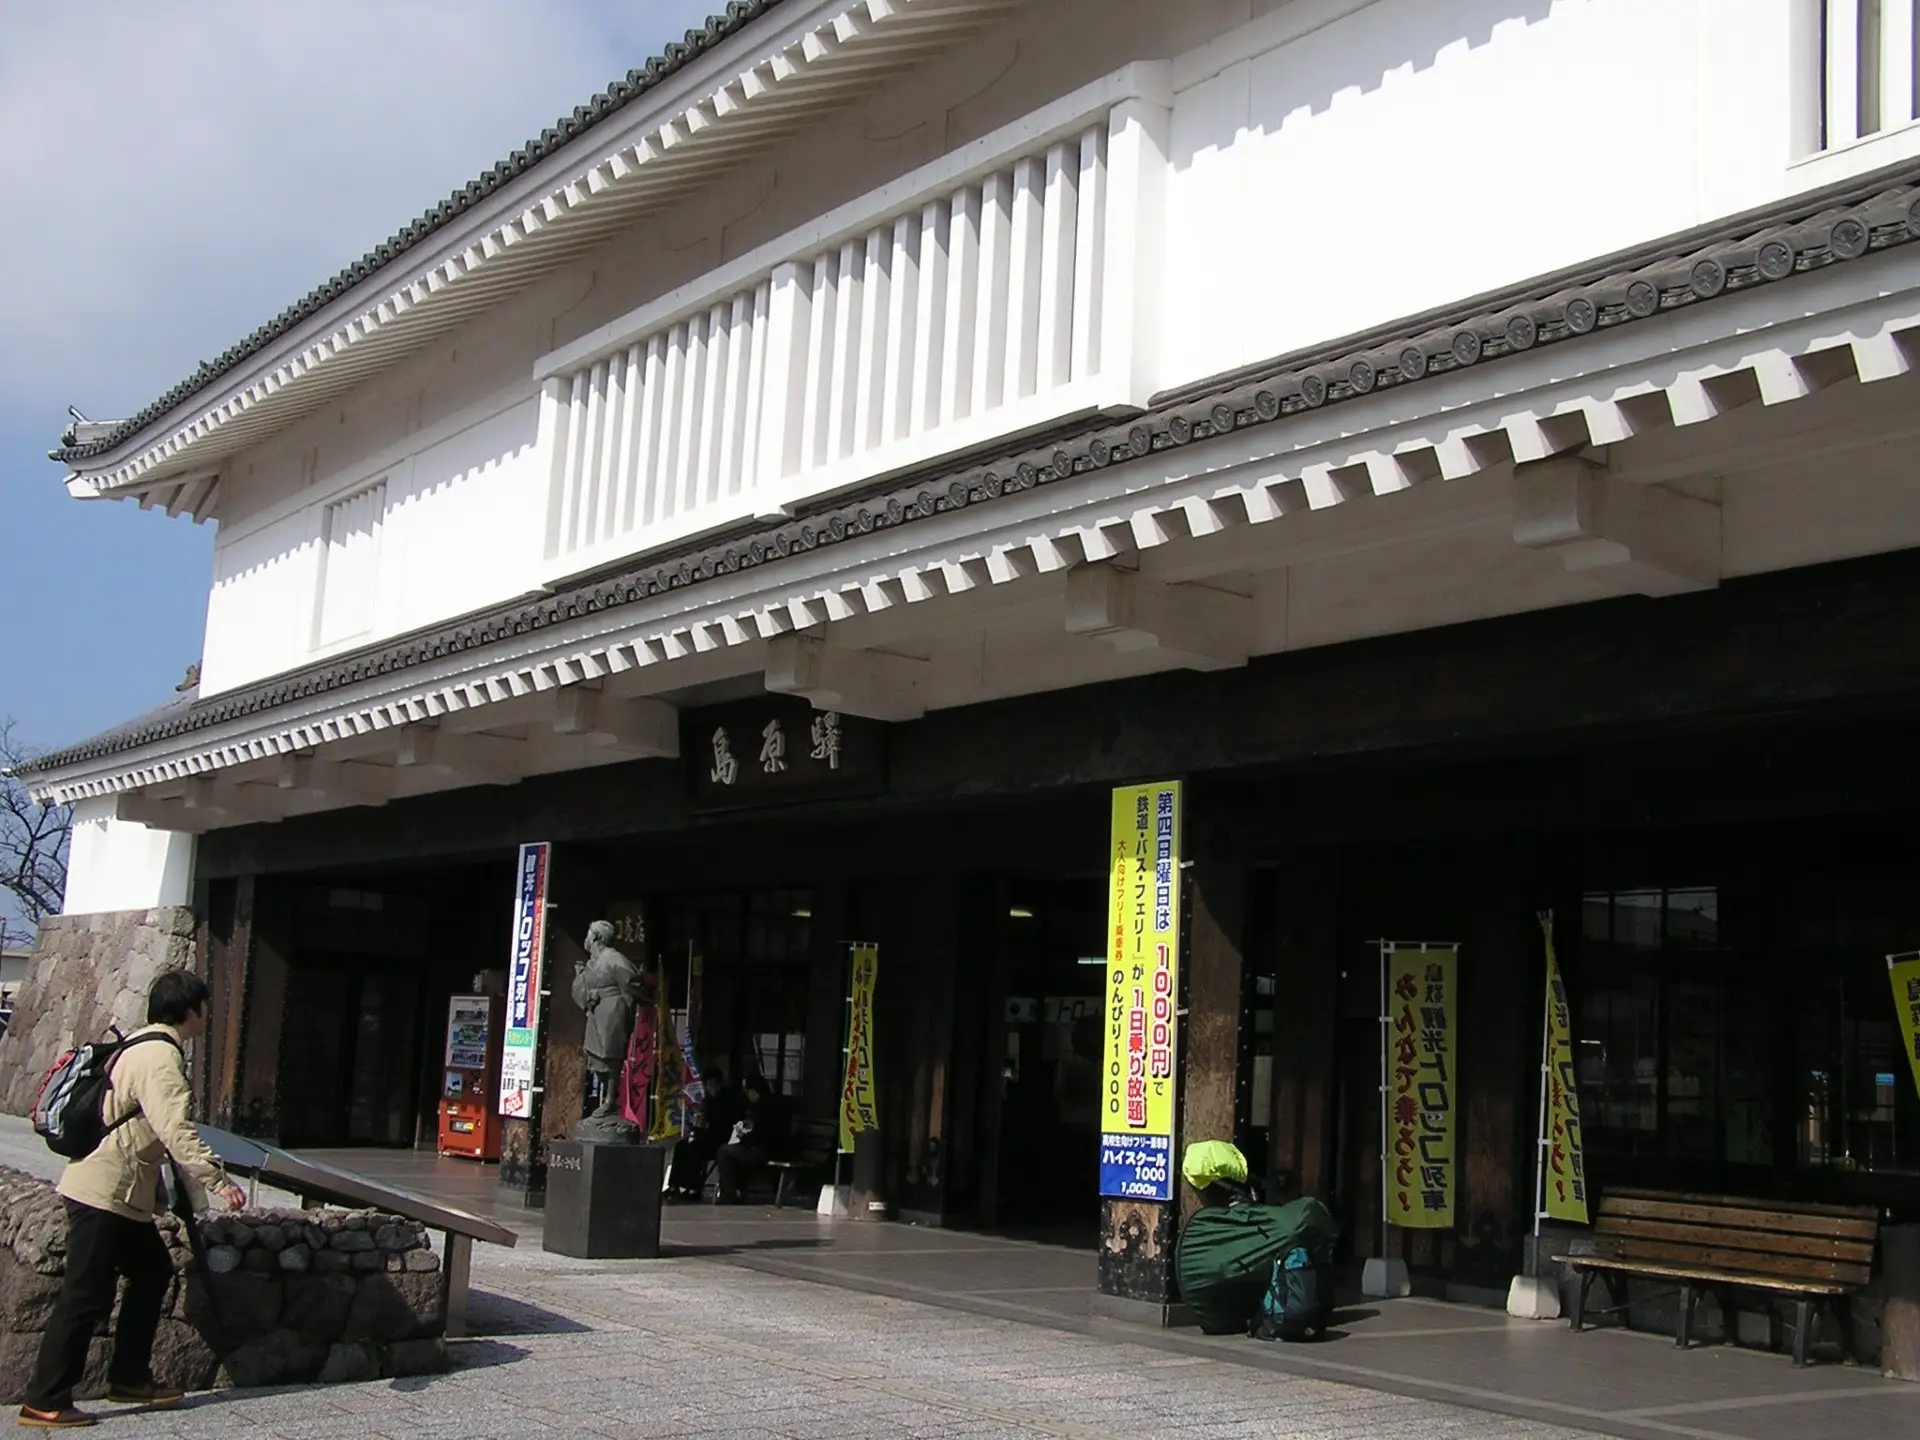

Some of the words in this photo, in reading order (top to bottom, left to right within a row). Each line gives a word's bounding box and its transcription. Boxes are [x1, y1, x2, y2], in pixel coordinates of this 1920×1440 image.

[1102, 1149, 1167, 1167] ハイスクール
[1135, 1166, 1166, 1182] 1000
